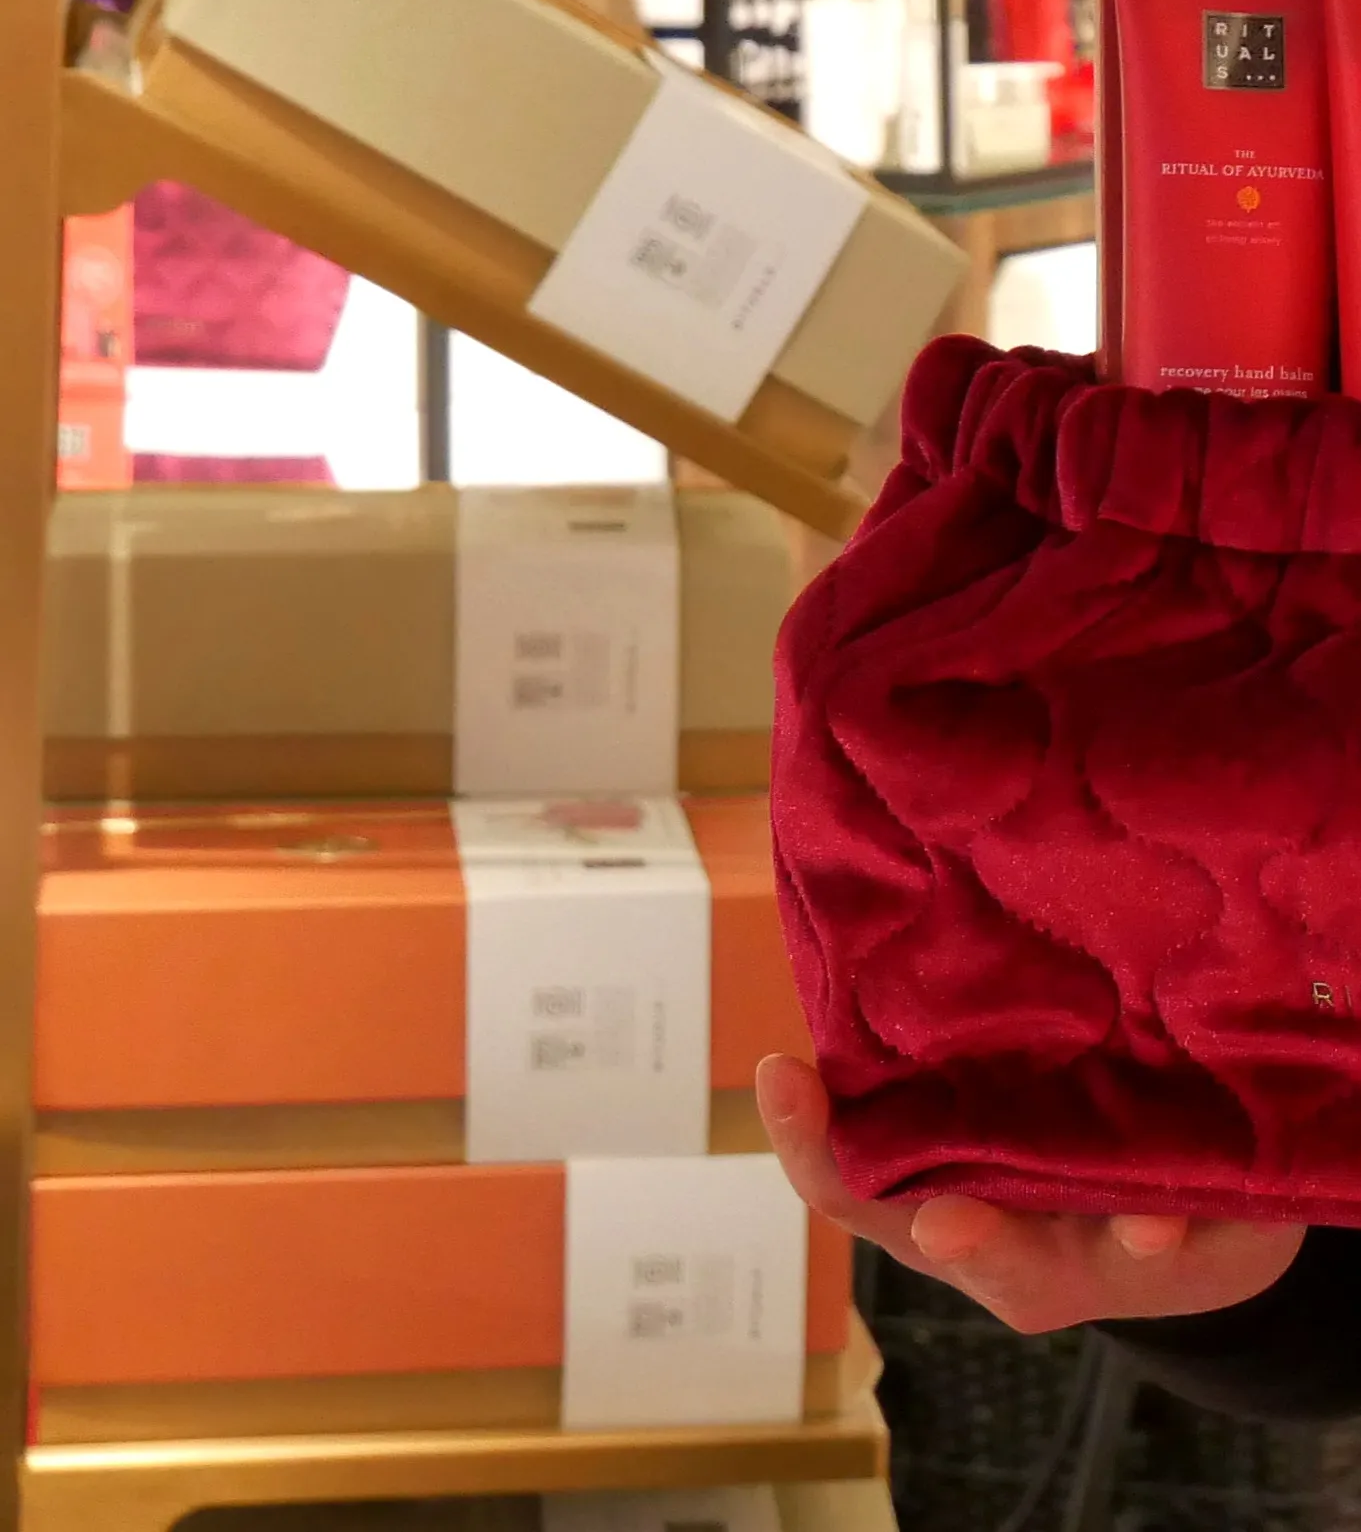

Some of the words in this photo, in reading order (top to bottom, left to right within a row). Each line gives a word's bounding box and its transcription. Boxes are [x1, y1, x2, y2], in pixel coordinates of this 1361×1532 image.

[1235, 149, 1256, 159] THE
[1161, 162, 1218, 176] RITUAL
[1222, 164, 1244, 177] OF
[1246, 165, 1325, 181] AYURVEDA
[1160, 366, 1229, 383] recovery
[1234, 364, 1274, 380] hand
[1280, 366, 1314, 381] balm
